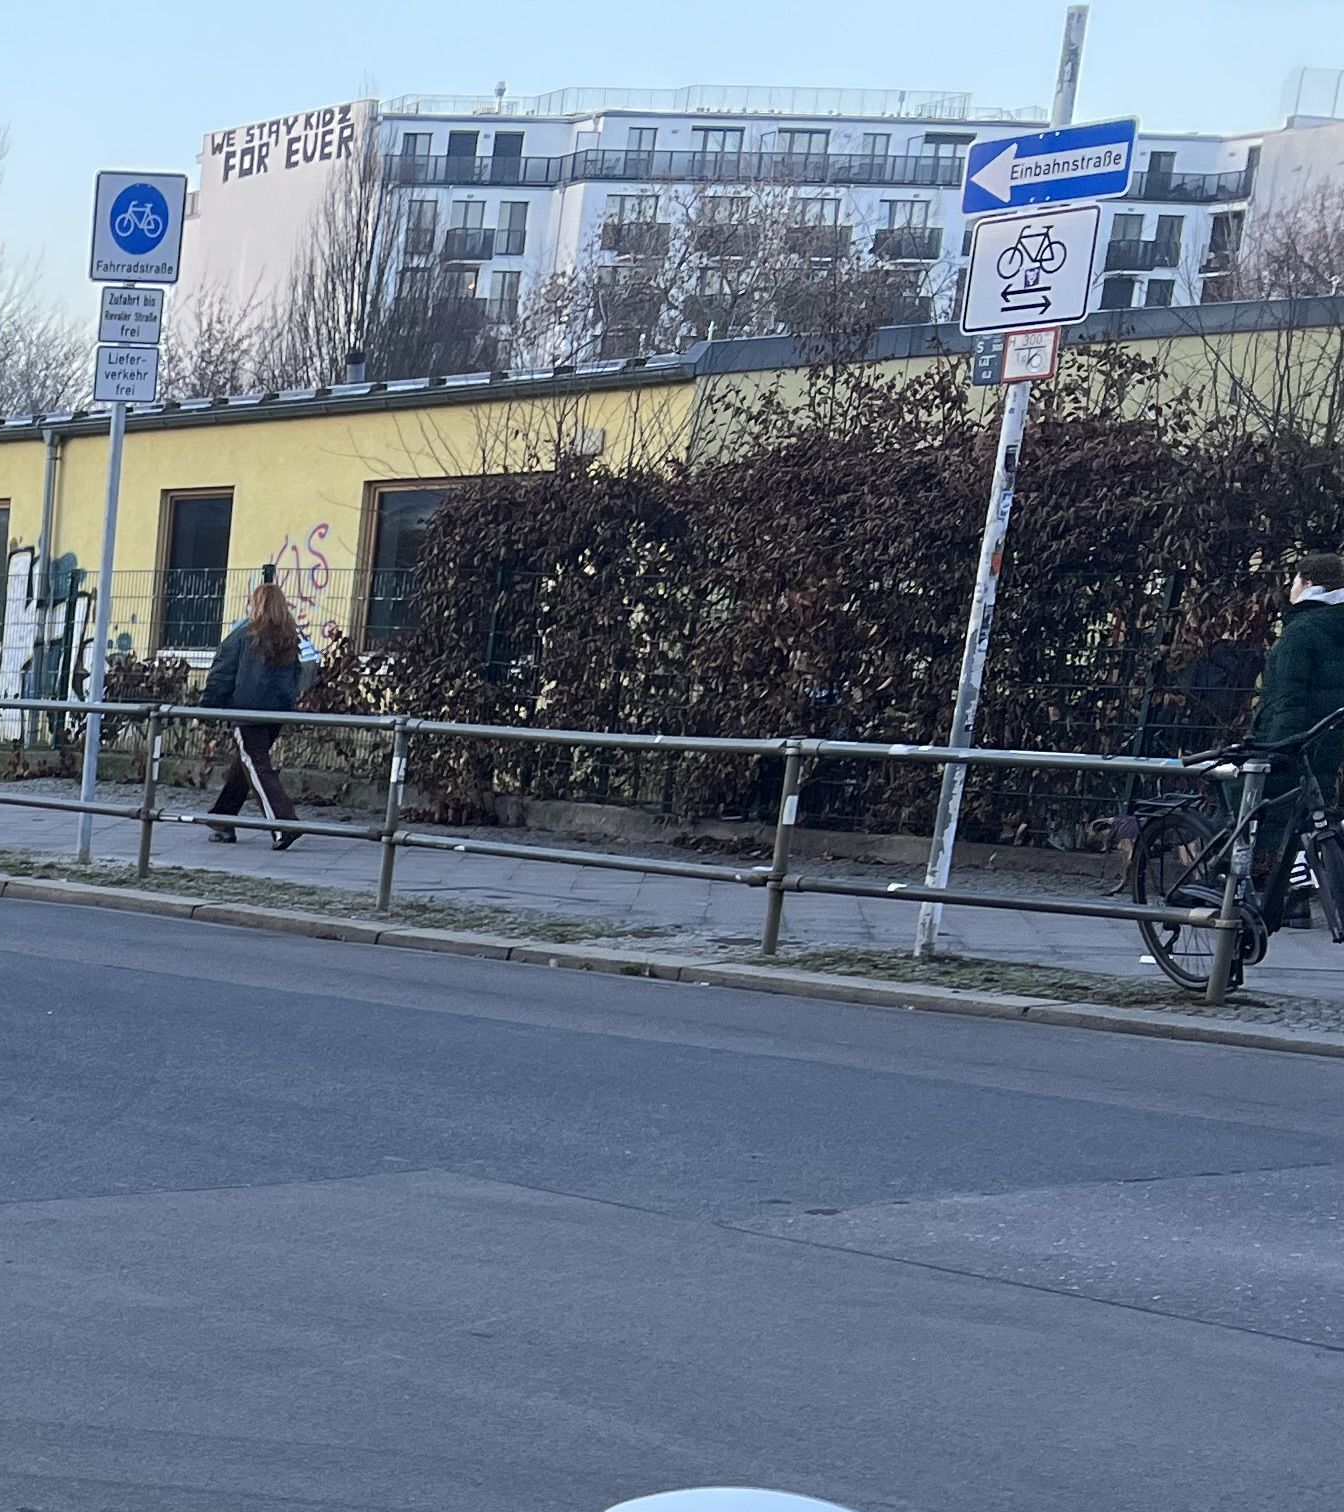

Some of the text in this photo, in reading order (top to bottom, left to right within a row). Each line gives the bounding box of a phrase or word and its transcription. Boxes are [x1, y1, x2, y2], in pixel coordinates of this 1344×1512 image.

[212, 104, 352, 155] WE STAY KIDZ
[223, 142, 270, 184] FOR
[1011, 151, 1122, 180] Einbahnstraße
[96, 260, 173, 275] Fahrradstraße
[109, 292, 156, 307] Zufahrt bis
[134, 311, 157, 322] Straße
[120, 324, 140, 337] frei
[108, 352, 147, 365] Liefer-
[104, 368, 148, 381] verkehr
[116, 383, 135, 396] frei
